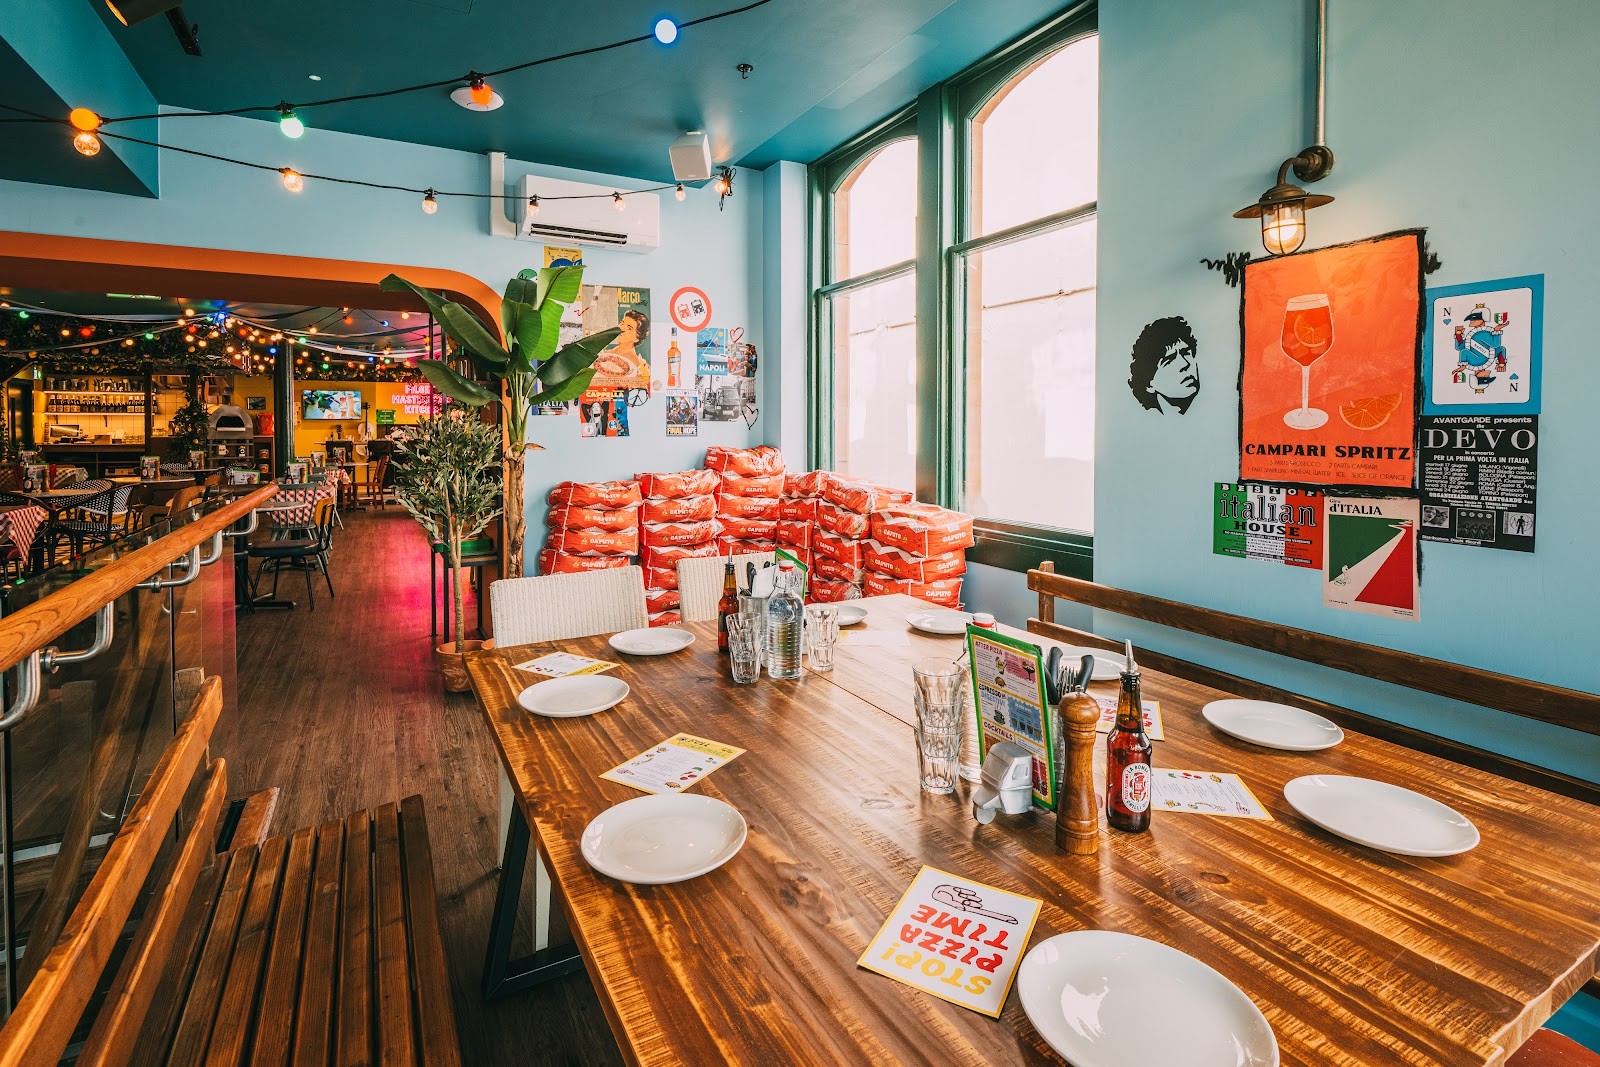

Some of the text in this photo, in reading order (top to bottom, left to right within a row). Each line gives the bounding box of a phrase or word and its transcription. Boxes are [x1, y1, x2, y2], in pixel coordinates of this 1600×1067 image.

[1443, 307, 1452, 317] N
[699, 364, 725, 372] NAPOLI
[1509, 382, 1518, 392] N
[667, 426, 697, 435] FINAL HOPE
[1423, 428, 1536, 451] DEVO
[1245, 444, 1411, 460] CAMPARI SPRITZ
[1508, 457, 1530, 465] ITALIA
[1220, 492, 1316, 527] italian
[1329, 503, 1382, 515] d'ITALIA
[883, 529, 902, 540] CAPUTO
[1233, 521, 1300, 537] HOUSE
[942, 531, 966, 542] CAPUTO
[874, 559, 894, 570] CAPUTO
[937, 559, 960, 570] CAPUTO
[983, 721, 1013, 741] COCKTAILS
[910, 904, 1009, 951] TIME
[900, 923, 1003, 973] PIZZA
[881, 942, 992, 995] STOP!
